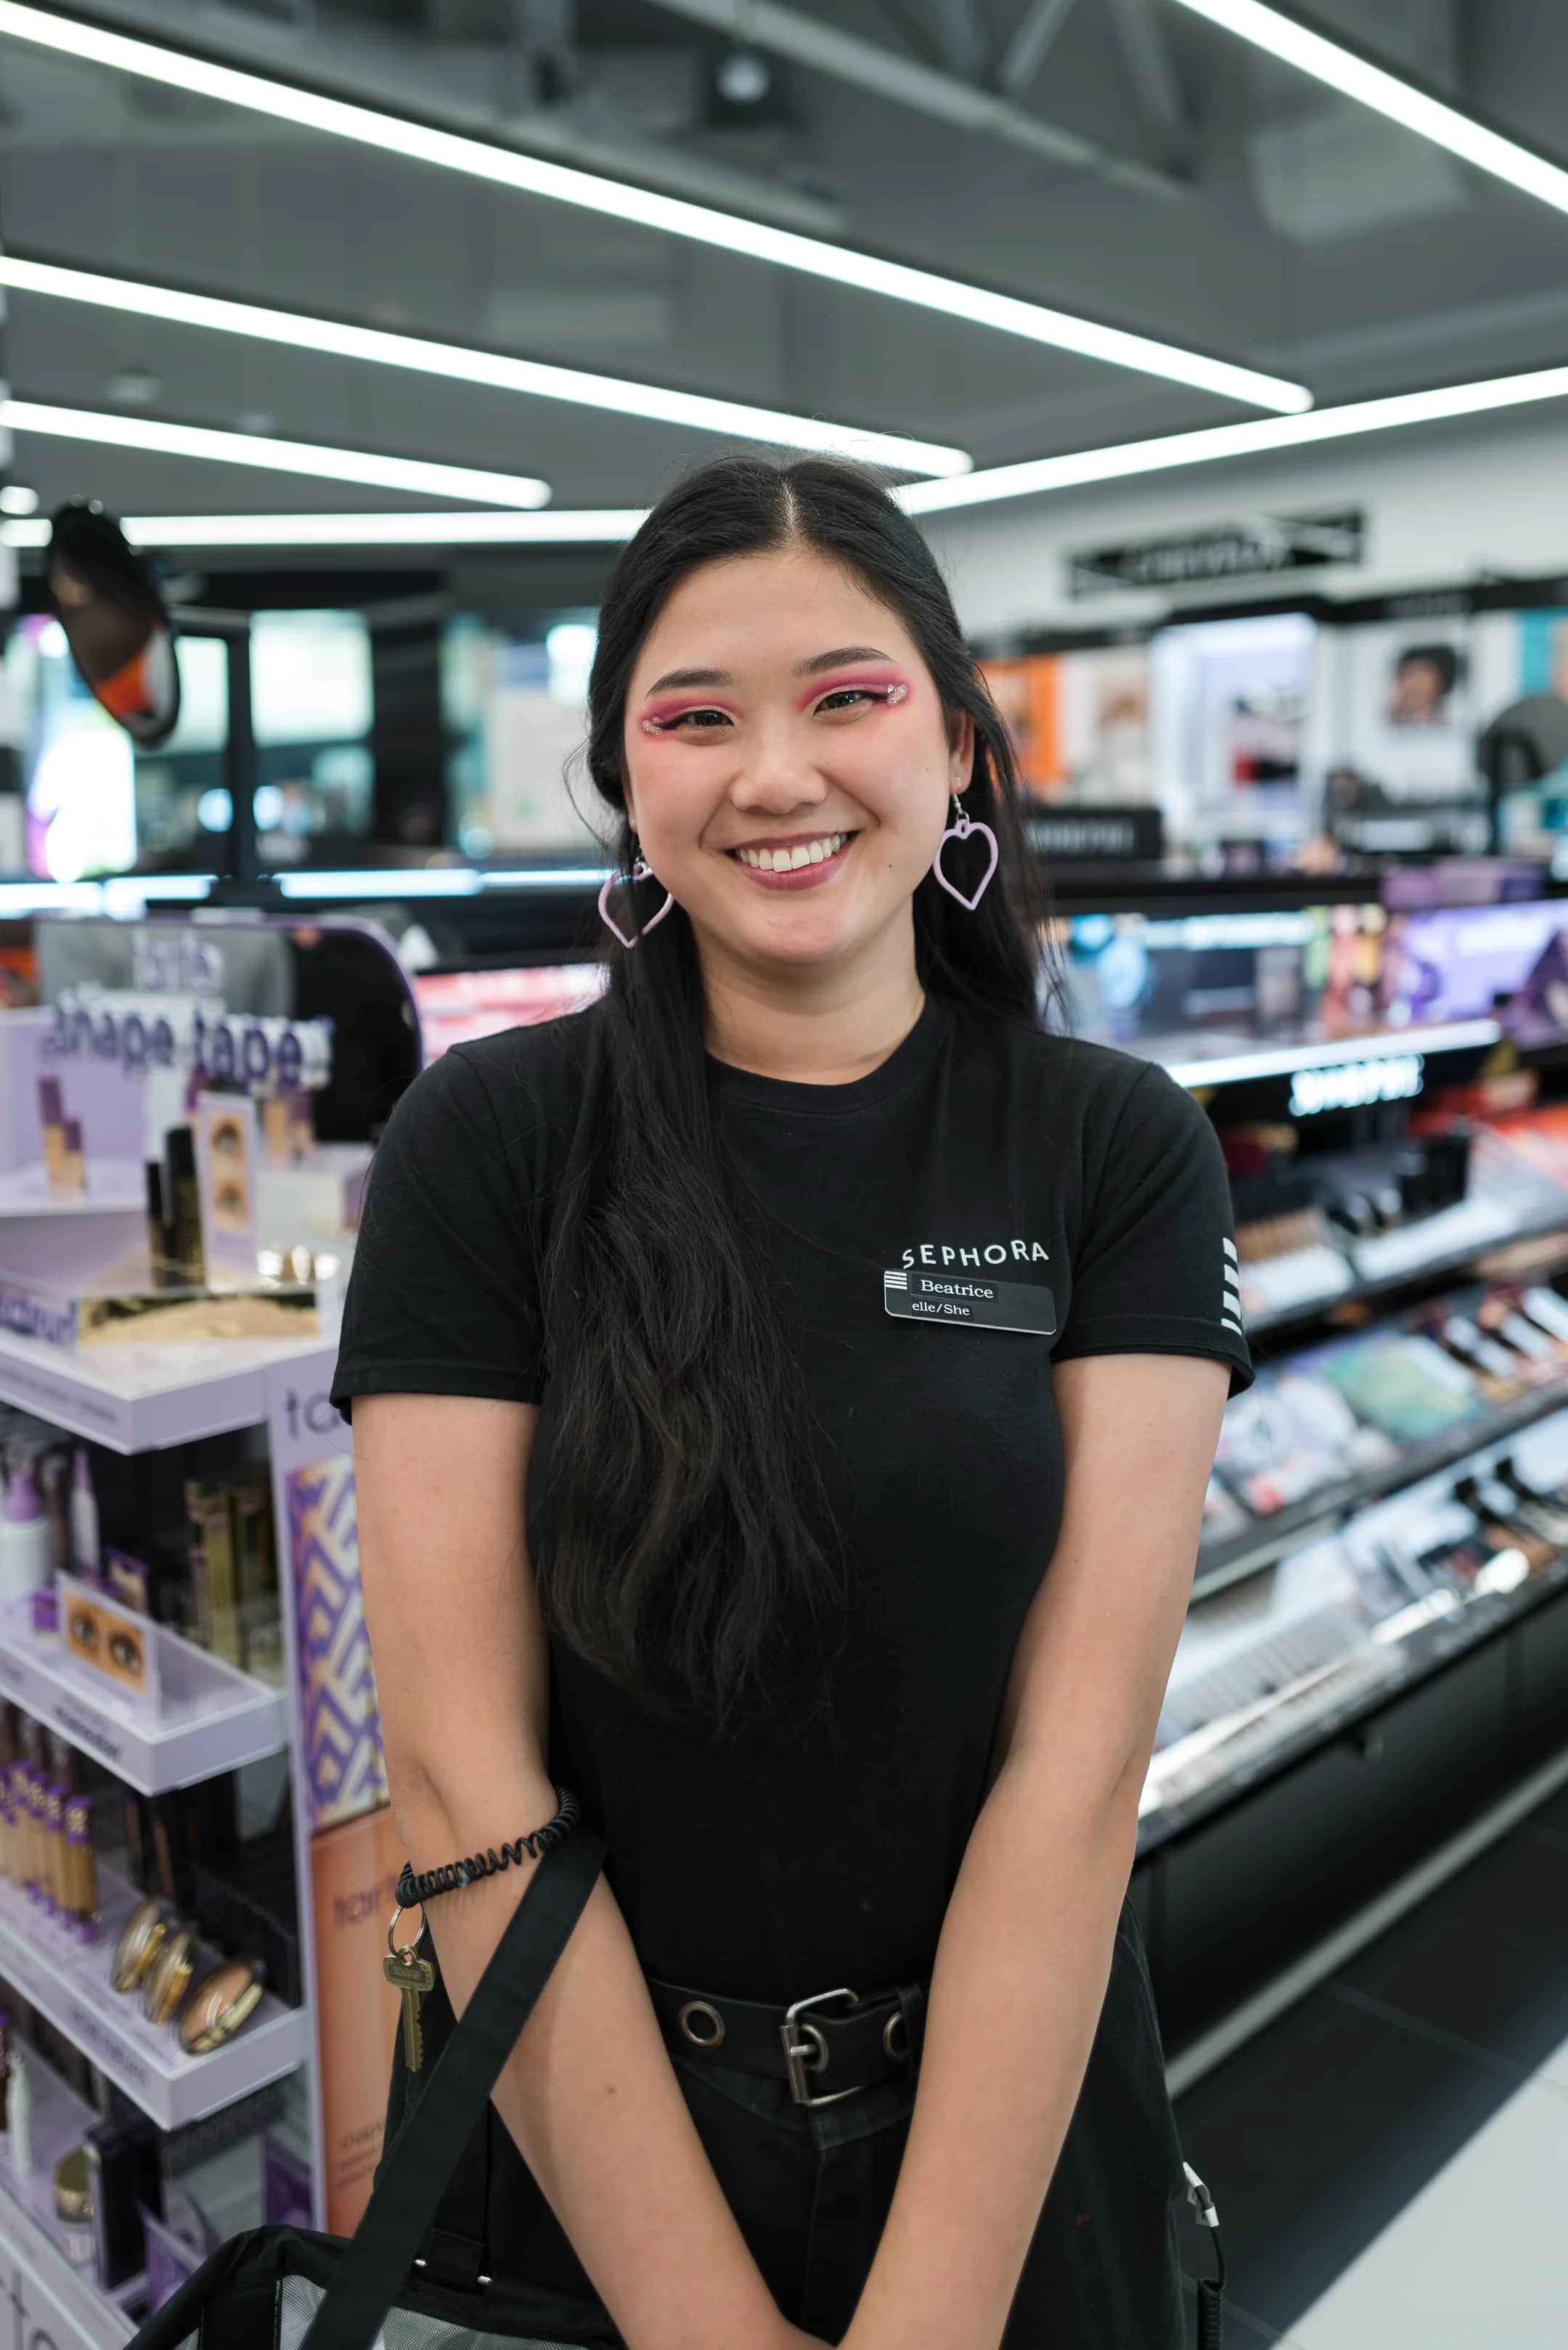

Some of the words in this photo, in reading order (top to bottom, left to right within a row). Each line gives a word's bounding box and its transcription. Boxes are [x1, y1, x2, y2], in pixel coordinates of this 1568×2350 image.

[192, 1008, 305, 1090] tape
[902, 1240, 1050, 1269] SEPHORA
[920, 1279, 995, 1299] Beatrice
[912, 1302, 971, 1316] elle/She
